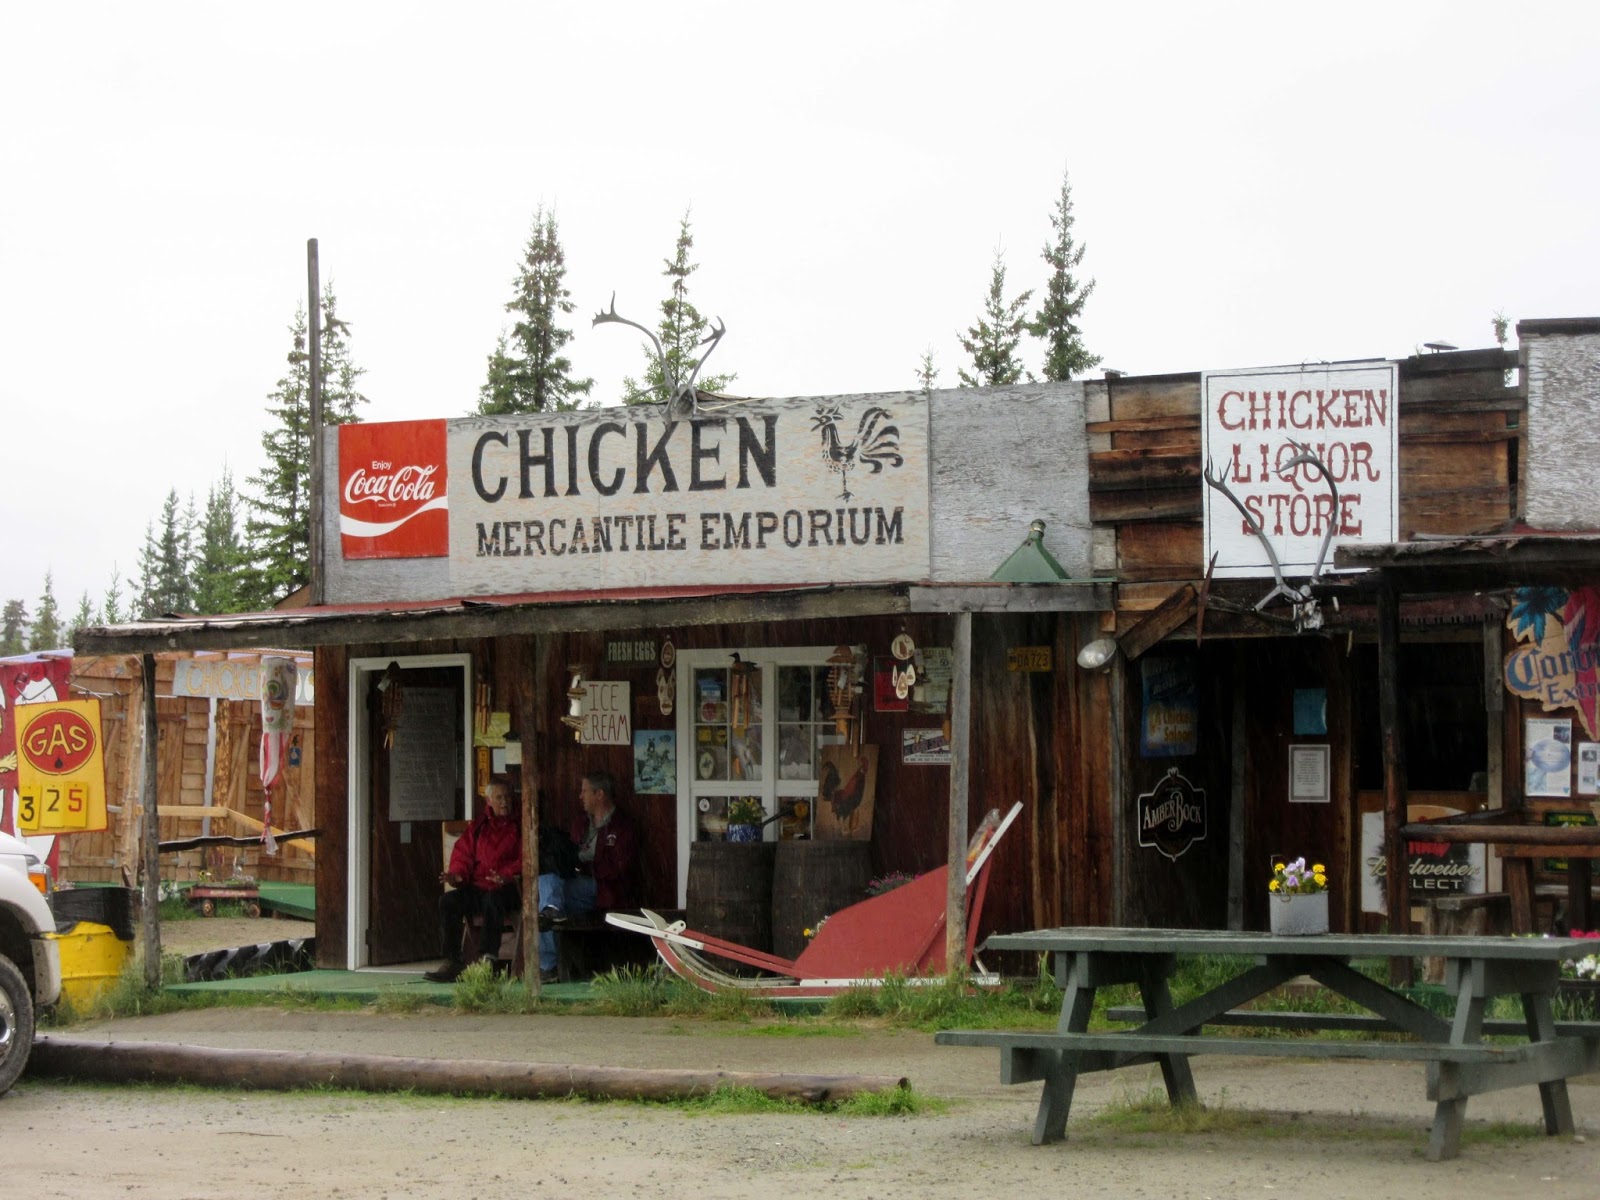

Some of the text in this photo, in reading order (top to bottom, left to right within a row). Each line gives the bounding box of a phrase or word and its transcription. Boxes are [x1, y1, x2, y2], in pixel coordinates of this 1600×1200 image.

[1217, 389, 1388, 431] CHICKEN
[372, 461, 392, 470] Enjoy
[472, 415, 780, 503] CHICKEN
[1232, 442, 1381, 491] LIQUOR
[345, 465, 439, 504] Coca-Cola
[476, 506, 905, 557] MERCANTILE EMPORIUM
[1242, 493, 1362, 537] STORE
[607, 641, 656, 661] FRESH EGGS
[589, 684, 619, 711] ICE
[26, 723, 88, 756] GAS
[582, 714, 630, 741] CREAM
[1367, 856, 1480, 877] Bdweiser
[1409, 878, 1463, 889] LECT
